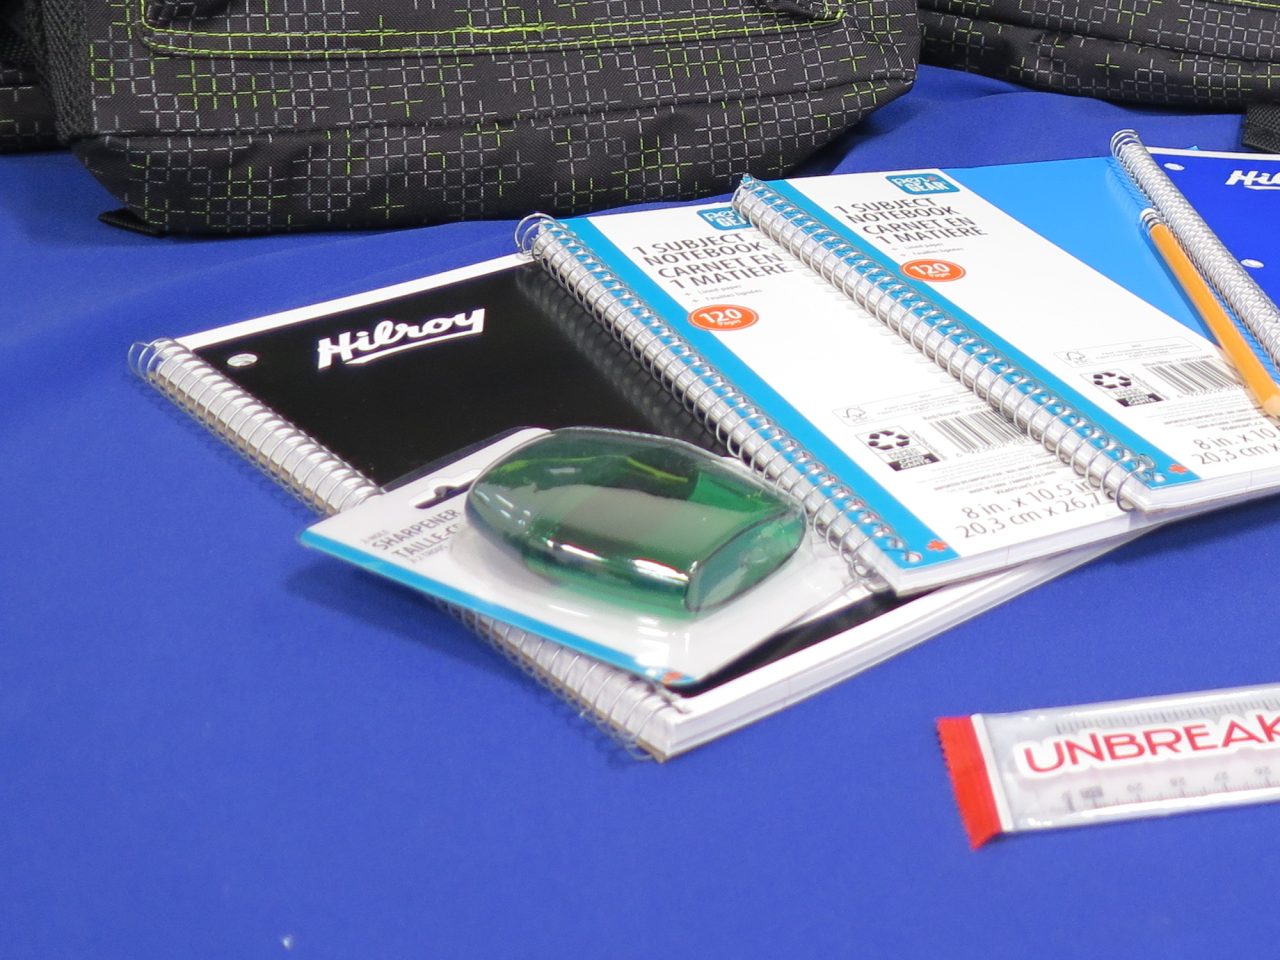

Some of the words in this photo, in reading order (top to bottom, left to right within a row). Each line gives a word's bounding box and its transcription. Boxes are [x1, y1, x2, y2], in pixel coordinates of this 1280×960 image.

[834, 205, 849, 214] 1
[851, 197, 938, 213] SUBJECT
[846, 206, 960, 224] NOTEBOOK
[862, 218, 945, 236] CARNET
[946, 216, 977, 227] EN
[633, 246, 648, 256] 1
[651, 232, 746, 254] SUBJECT
[875, 235, 891, 245] 1
[643, 241, 768, 267] NOTEBOOK
[658, 256, 750, 279] CARNET
[750, 252, 784, 264] EN
[910, 262, 950, 275] 120
[670, 279, 685, 289] 1
[698, 308, 743, 324] 120
[317, 307, 486, 369] Hilroy
[1193, 438, 1211, 451] 8
[1241, 433, 1255, 443] x
[1191, 447, 1237, 465] 20,3
[1239, 443, 1270, 456] cm
[960, 506, 980, 520] 8
[1012, 497, 1029, 508] x
[1026, 483, 1073, 503] 10.5
[371, 508, 462, 550] SHARPENER
[955, 517, 1006, 539] 20,3
[1009, 509, 1043, 525] cm
[1042, 505, 1059, 517] x
